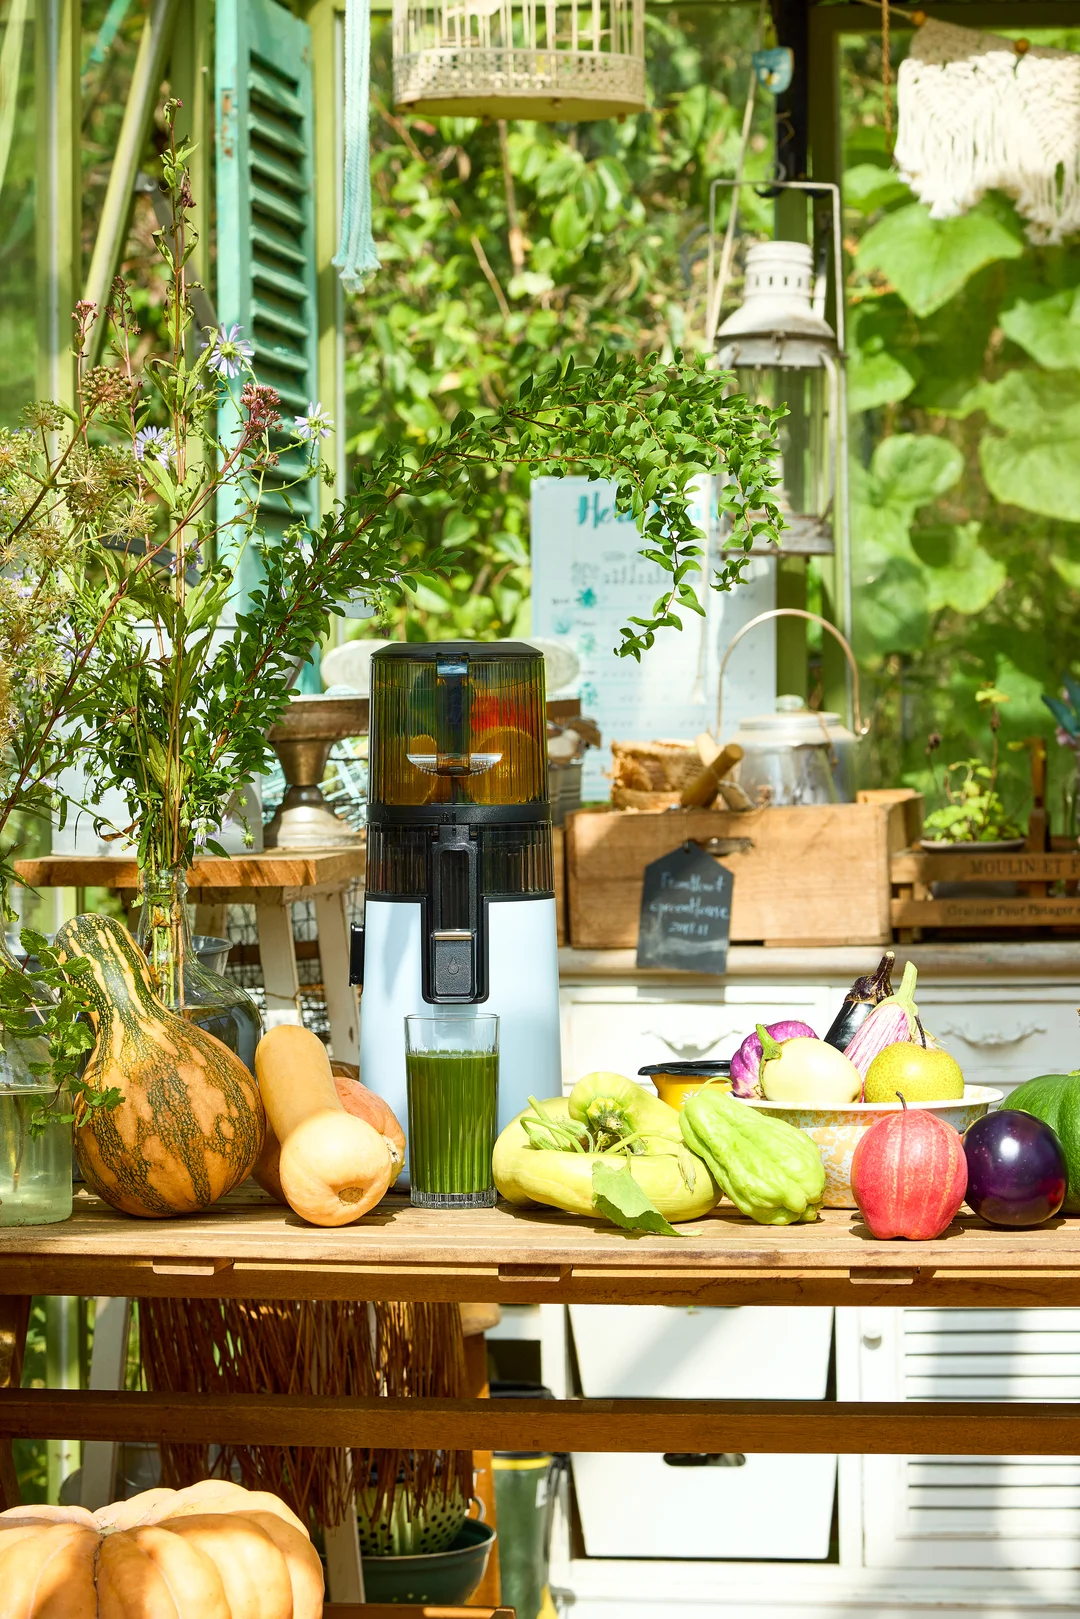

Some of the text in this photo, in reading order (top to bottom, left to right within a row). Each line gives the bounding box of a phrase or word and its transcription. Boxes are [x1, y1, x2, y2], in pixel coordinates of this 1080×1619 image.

[970, 858, 1035, 875] MOULIN
[1043, 858, 1064, 875] ET
[996, 904, 1026, 916] Pour
